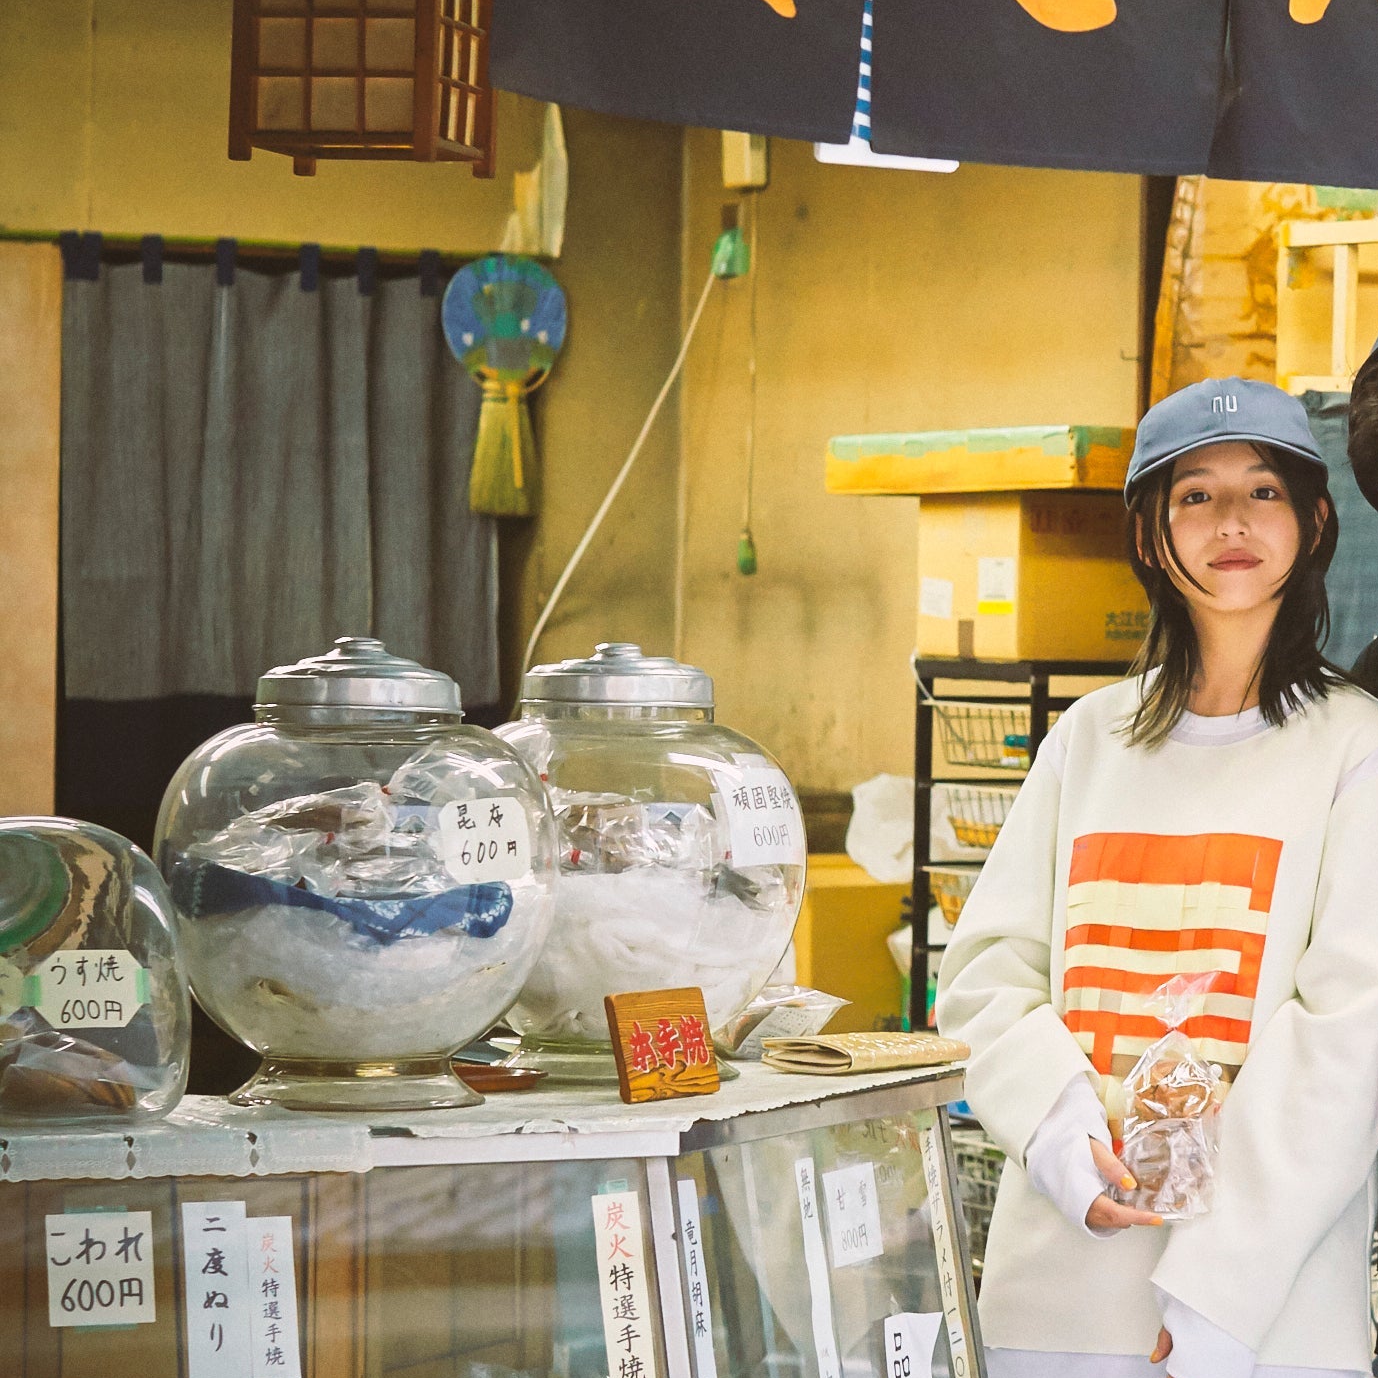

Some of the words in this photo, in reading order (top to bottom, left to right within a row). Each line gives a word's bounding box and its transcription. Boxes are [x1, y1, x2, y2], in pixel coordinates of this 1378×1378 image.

[753, 824, 791, 847] 600円
[461, 839, 517, 866] 600円
[50, 954, 124, 987] うす焼
[60, 999, 123, 1024] 600円
[50, 1227, 143, 1266] こわれ
[60, 1277, 144, 1313] 600円
[201, 1215, 230, 1353] 二度ぬり
